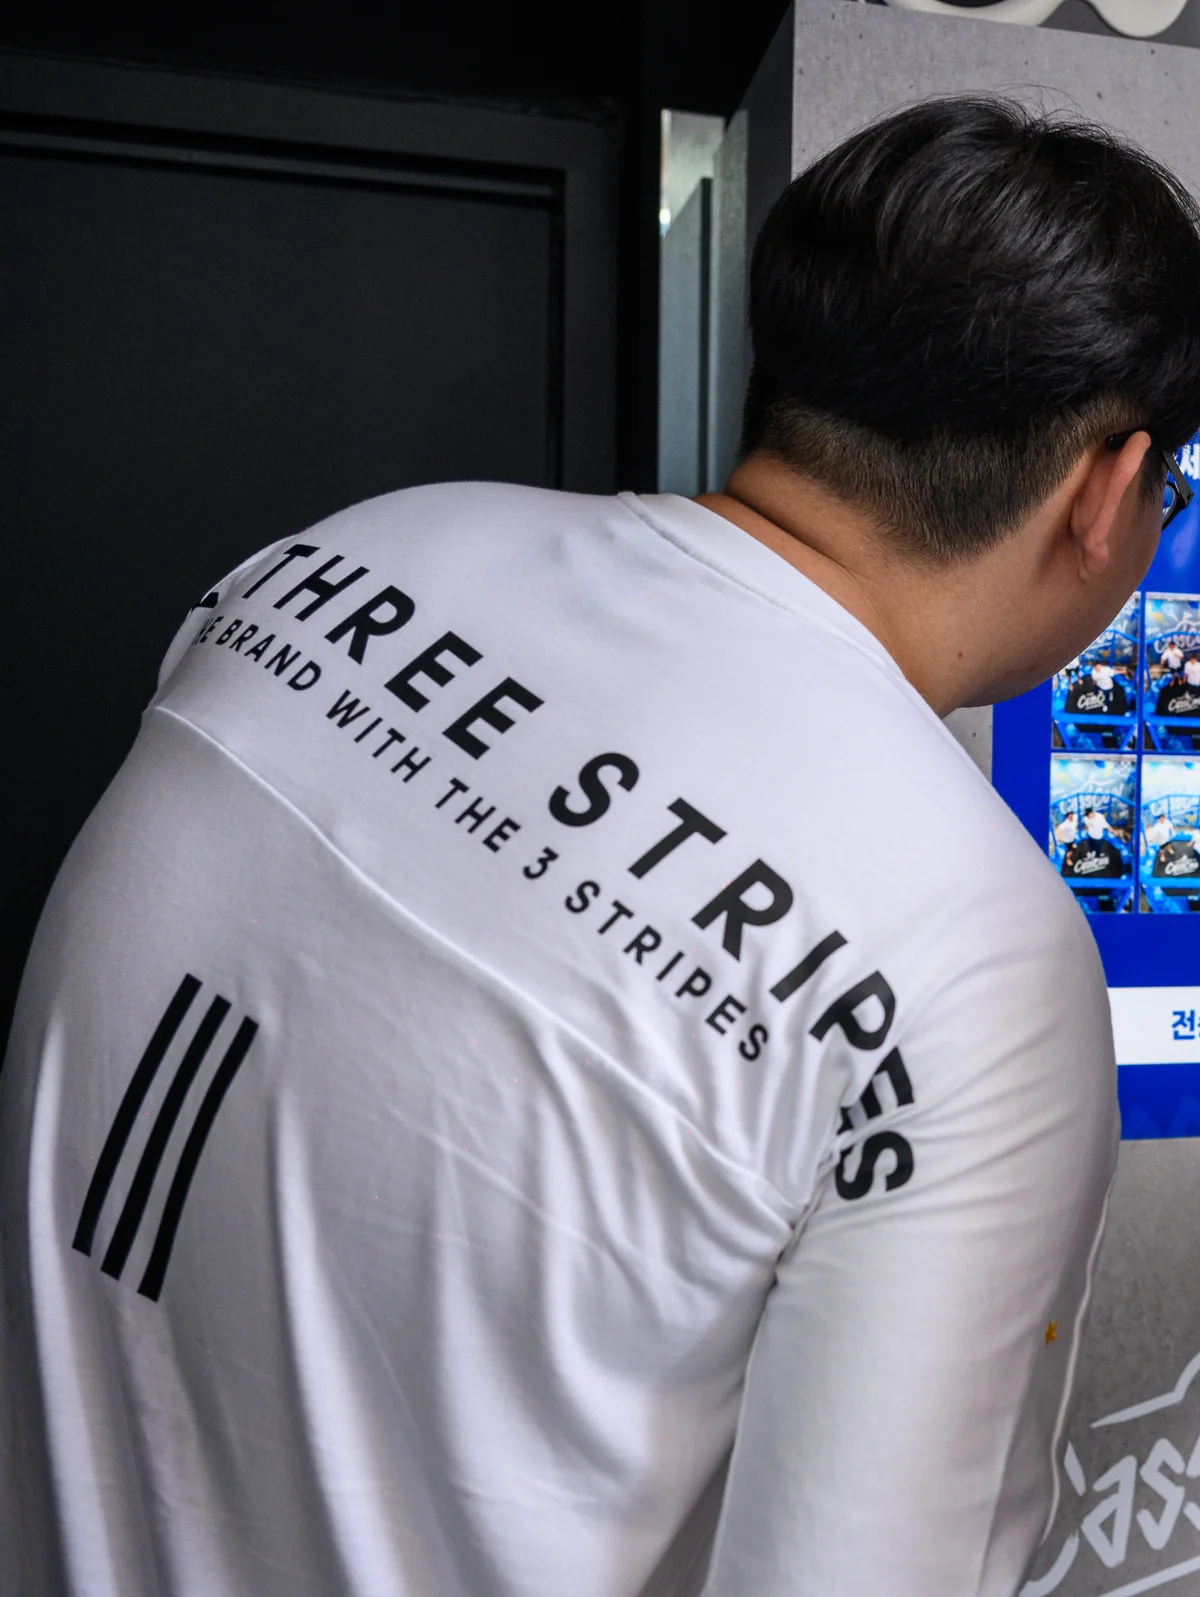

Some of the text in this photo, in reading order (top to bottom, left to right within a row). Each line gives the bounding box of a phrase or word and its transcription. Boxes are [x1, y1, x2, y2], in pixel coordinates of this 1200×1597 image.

[192, 616, 769, 1062] HE BRAND WITH THE 3 STRIPES
[241, 543, 915, 1201] THREE STRIPES
